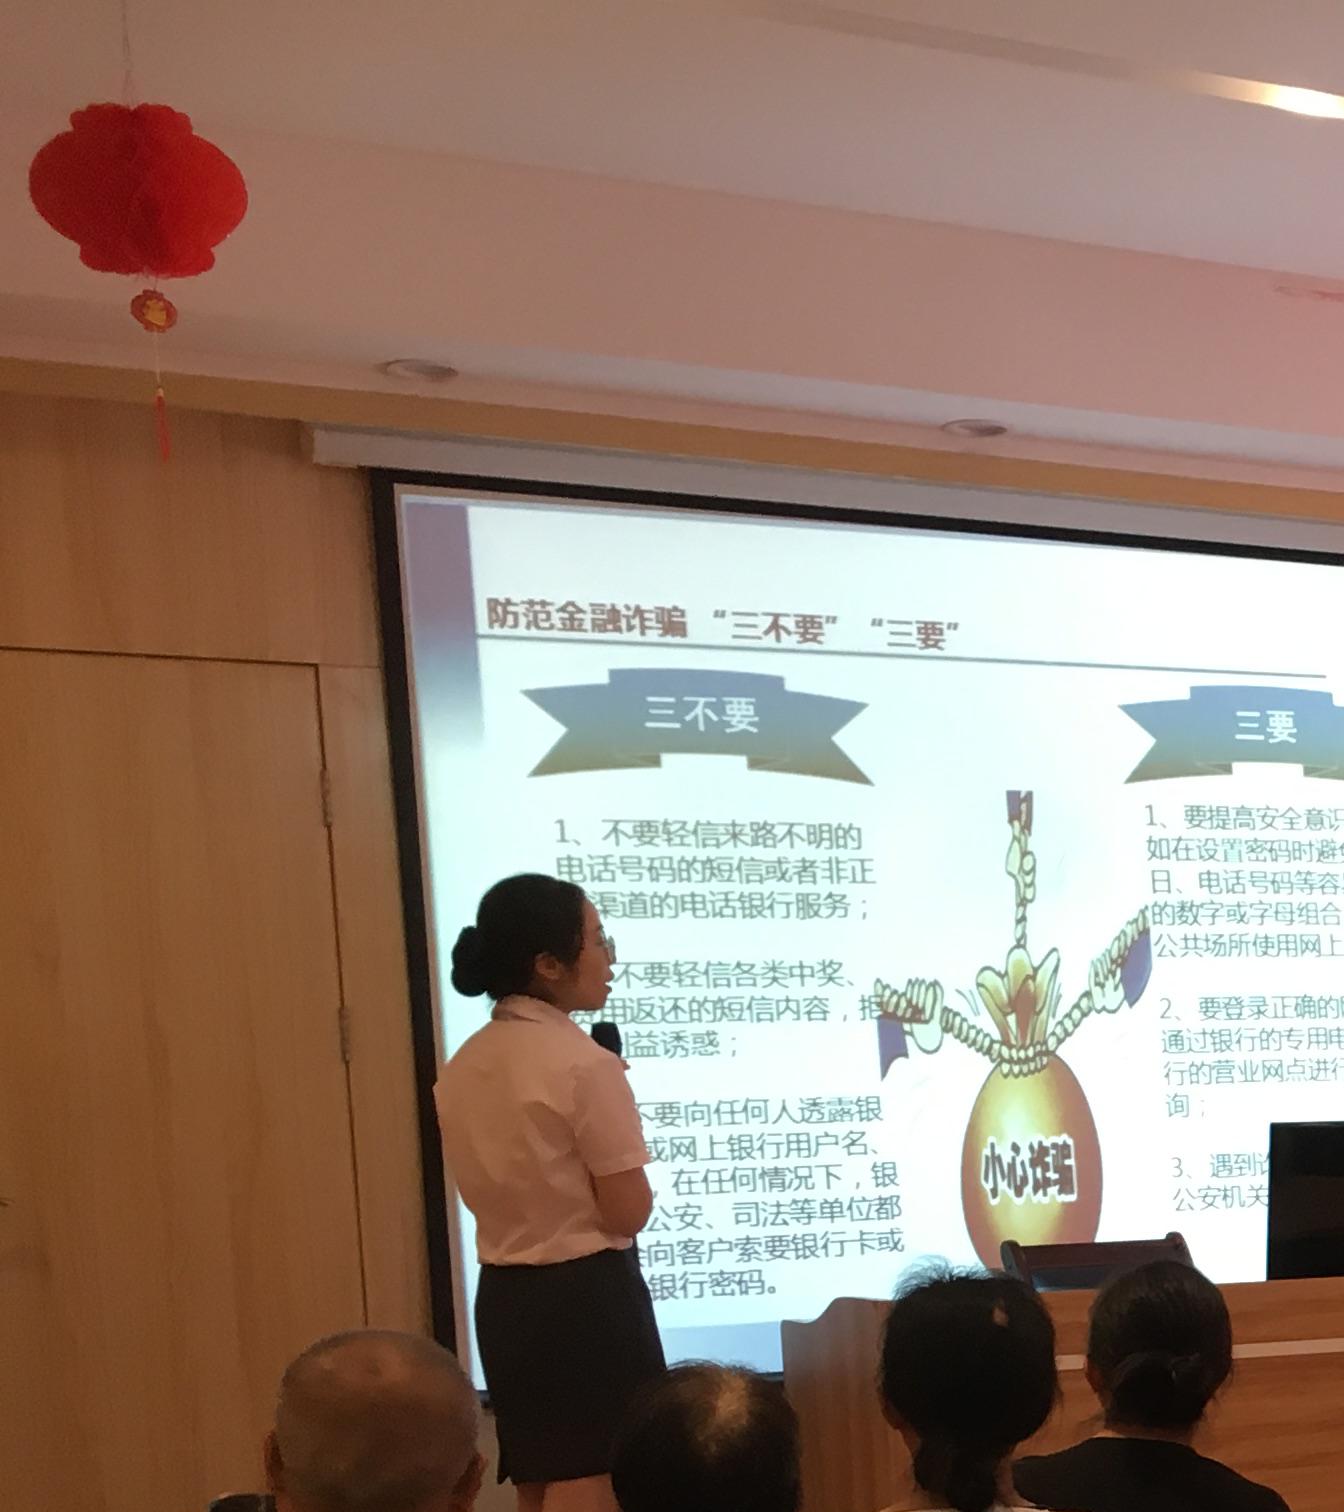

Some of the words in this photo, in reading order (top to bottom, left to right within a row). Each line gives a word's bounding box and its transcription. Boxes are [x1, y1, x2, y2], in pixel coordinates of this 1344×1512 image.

[485, 597, 689, 639] 防范金融诈骗
[643, 696, 760, 734] 三不要
[1234, 709, 1298, 744] 三要
[556, 854, 877, 885] 电话号码的短信或者非正
[981, 1136, 1077, 1203] 小心诈骗
[1172, 1184, 1269, 1212] 公安机关
